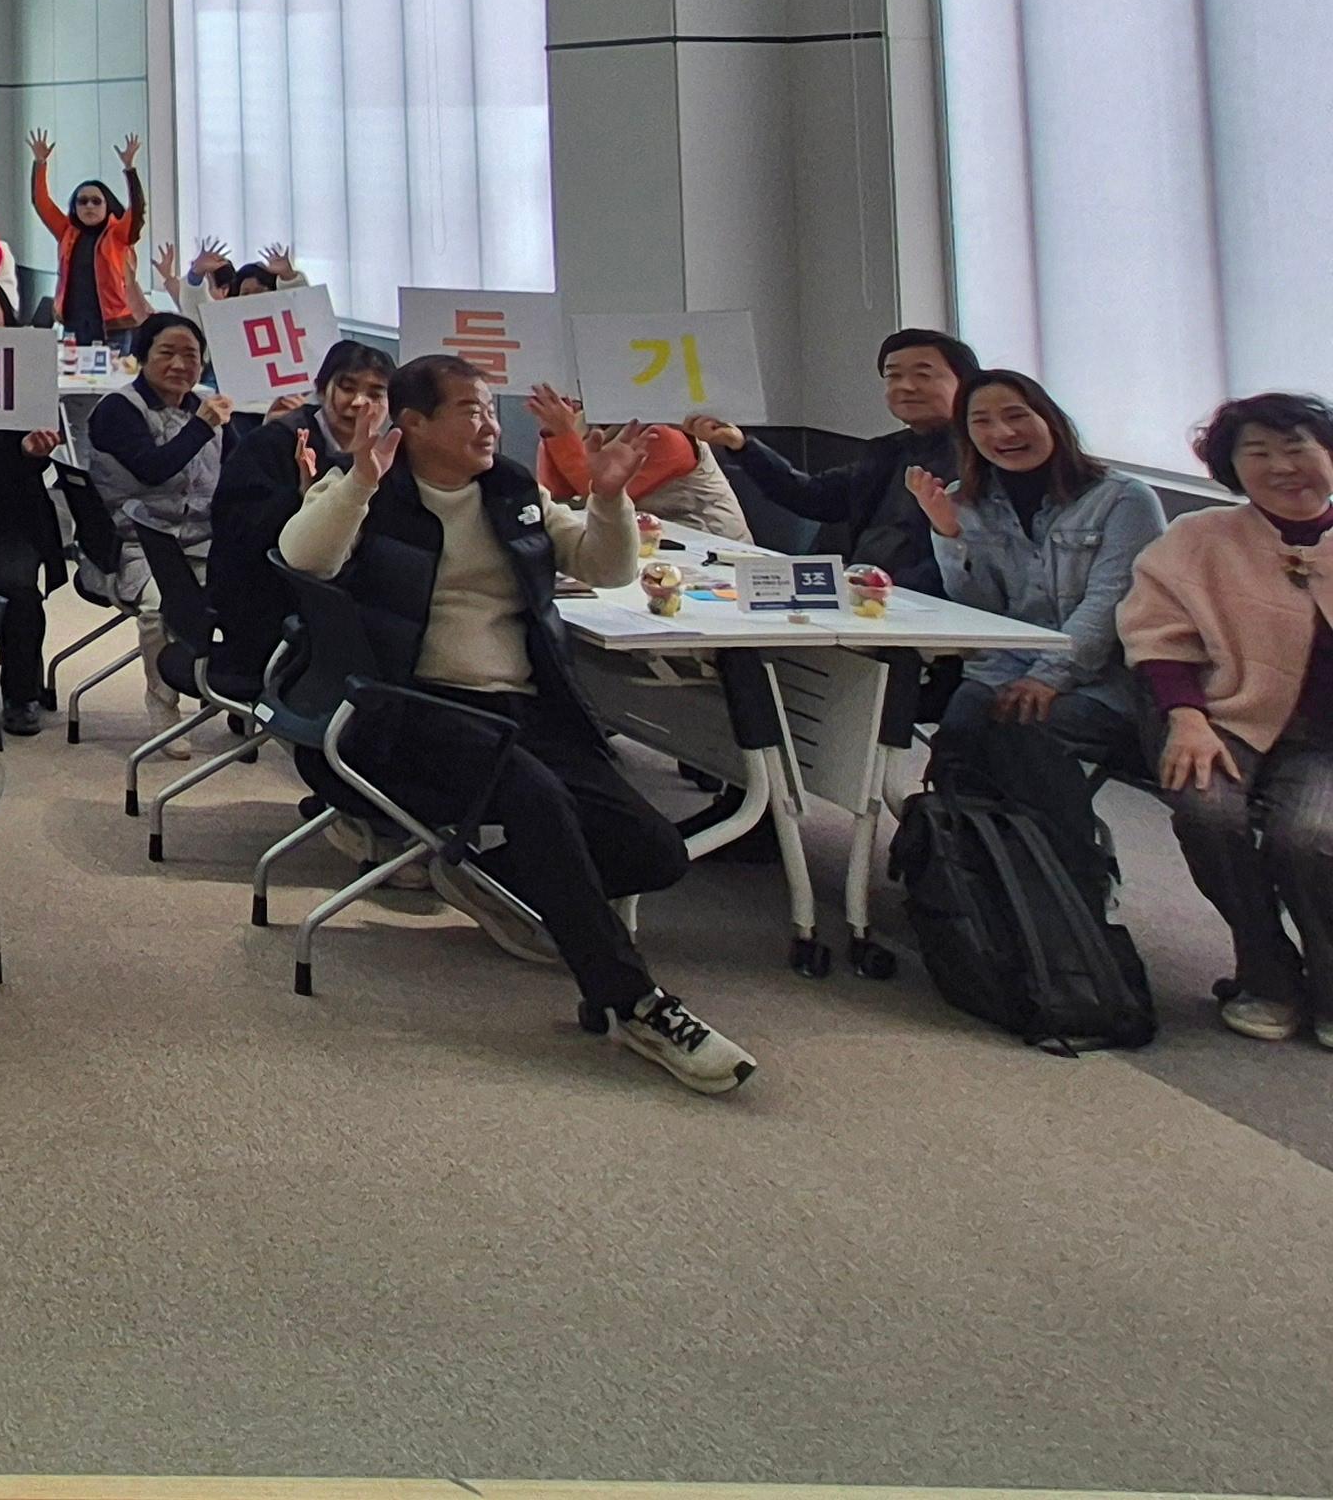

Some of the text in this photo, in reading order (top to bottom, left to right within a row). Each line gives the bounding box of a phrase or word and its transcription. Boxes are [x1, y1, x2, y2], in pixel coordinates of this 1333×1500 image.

[242, 310, 309, 388] 만
[442, 309, 521, 385] 들
[629, 334, 707, 402] 기
[801, 572, 827, 586] 3조
